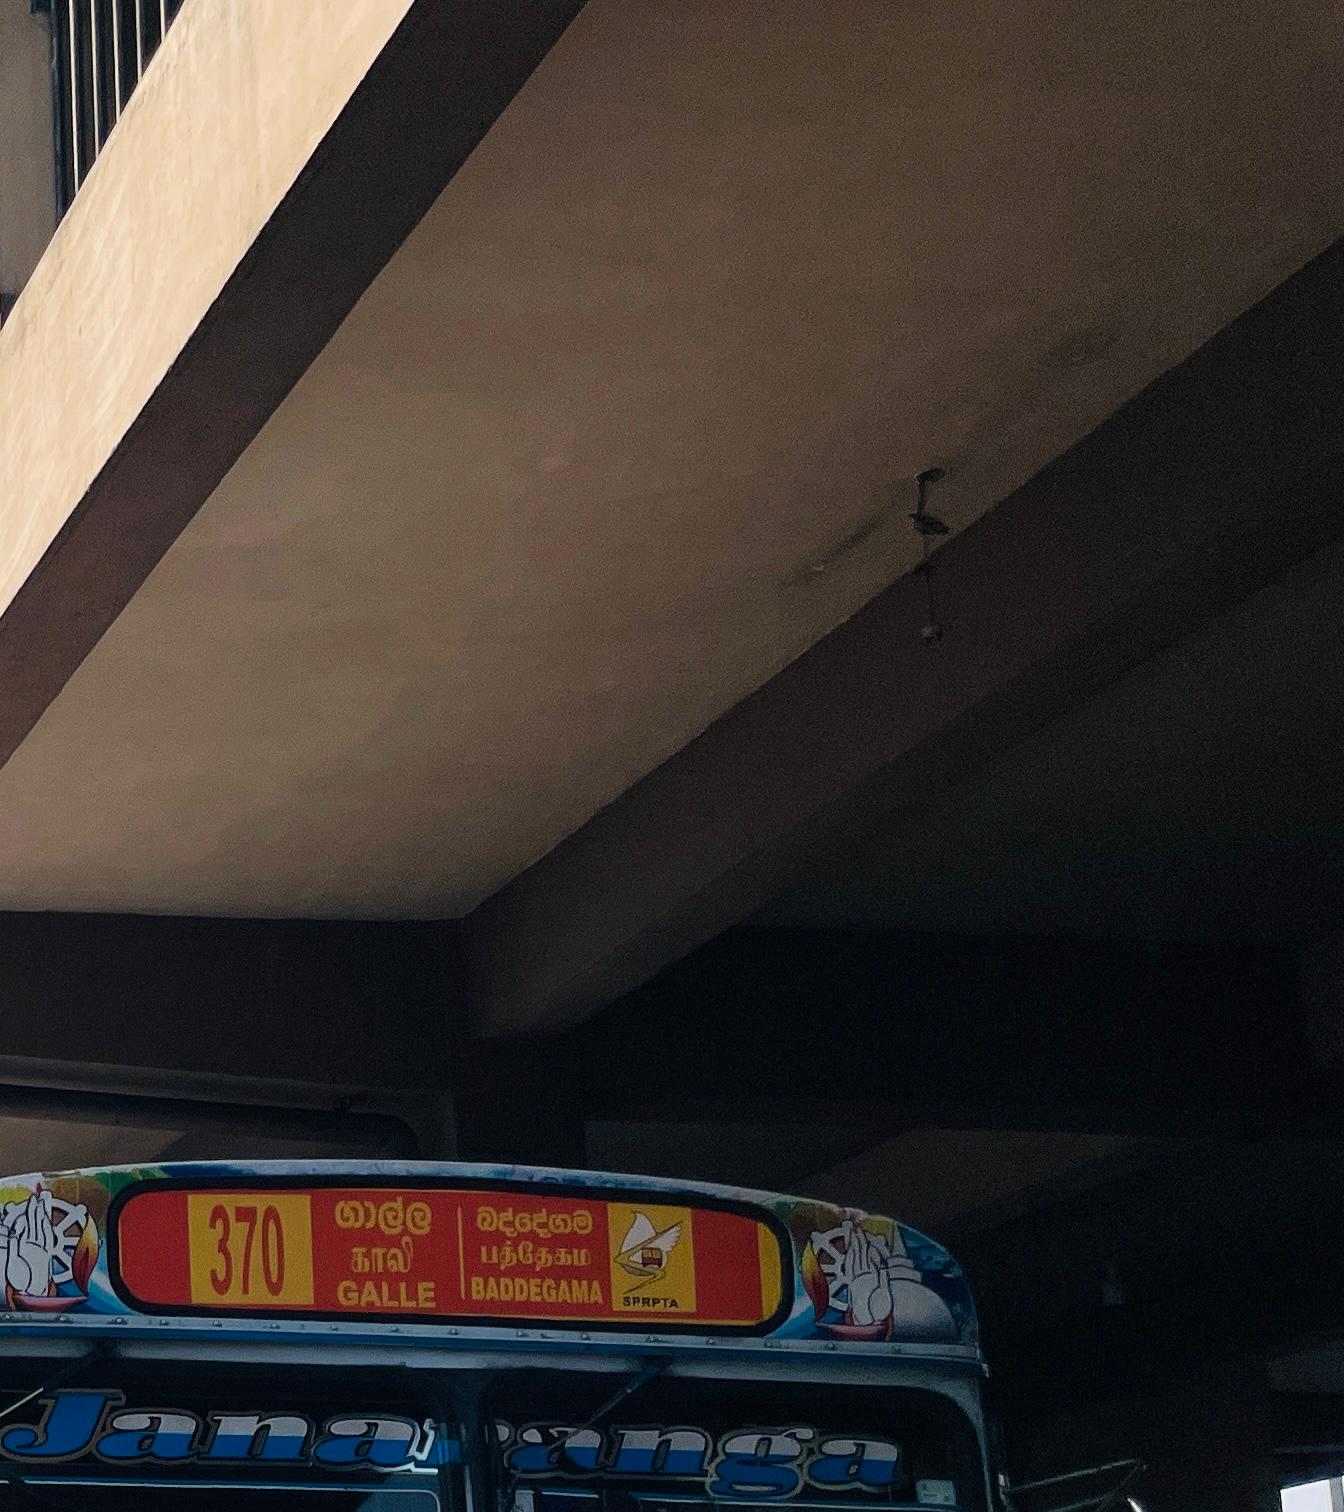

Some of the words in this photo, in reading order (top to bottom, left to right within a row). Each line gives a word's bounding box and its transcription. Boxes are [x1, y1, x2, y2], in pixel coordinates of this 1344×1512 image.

[335, 1196, 432, 1235] ගාල්ල
[476, 1205, 593, 1238] බද්දේගම
[209, 1204, 285, 1296] 370
[351, 1236, 413, 1273] காலி
[337, 1280, 436, 1308] GALLE
[471, 1276, 604, 1304] BADDEGAMA
[623, 1296, 679, 1309] SPRPTA
